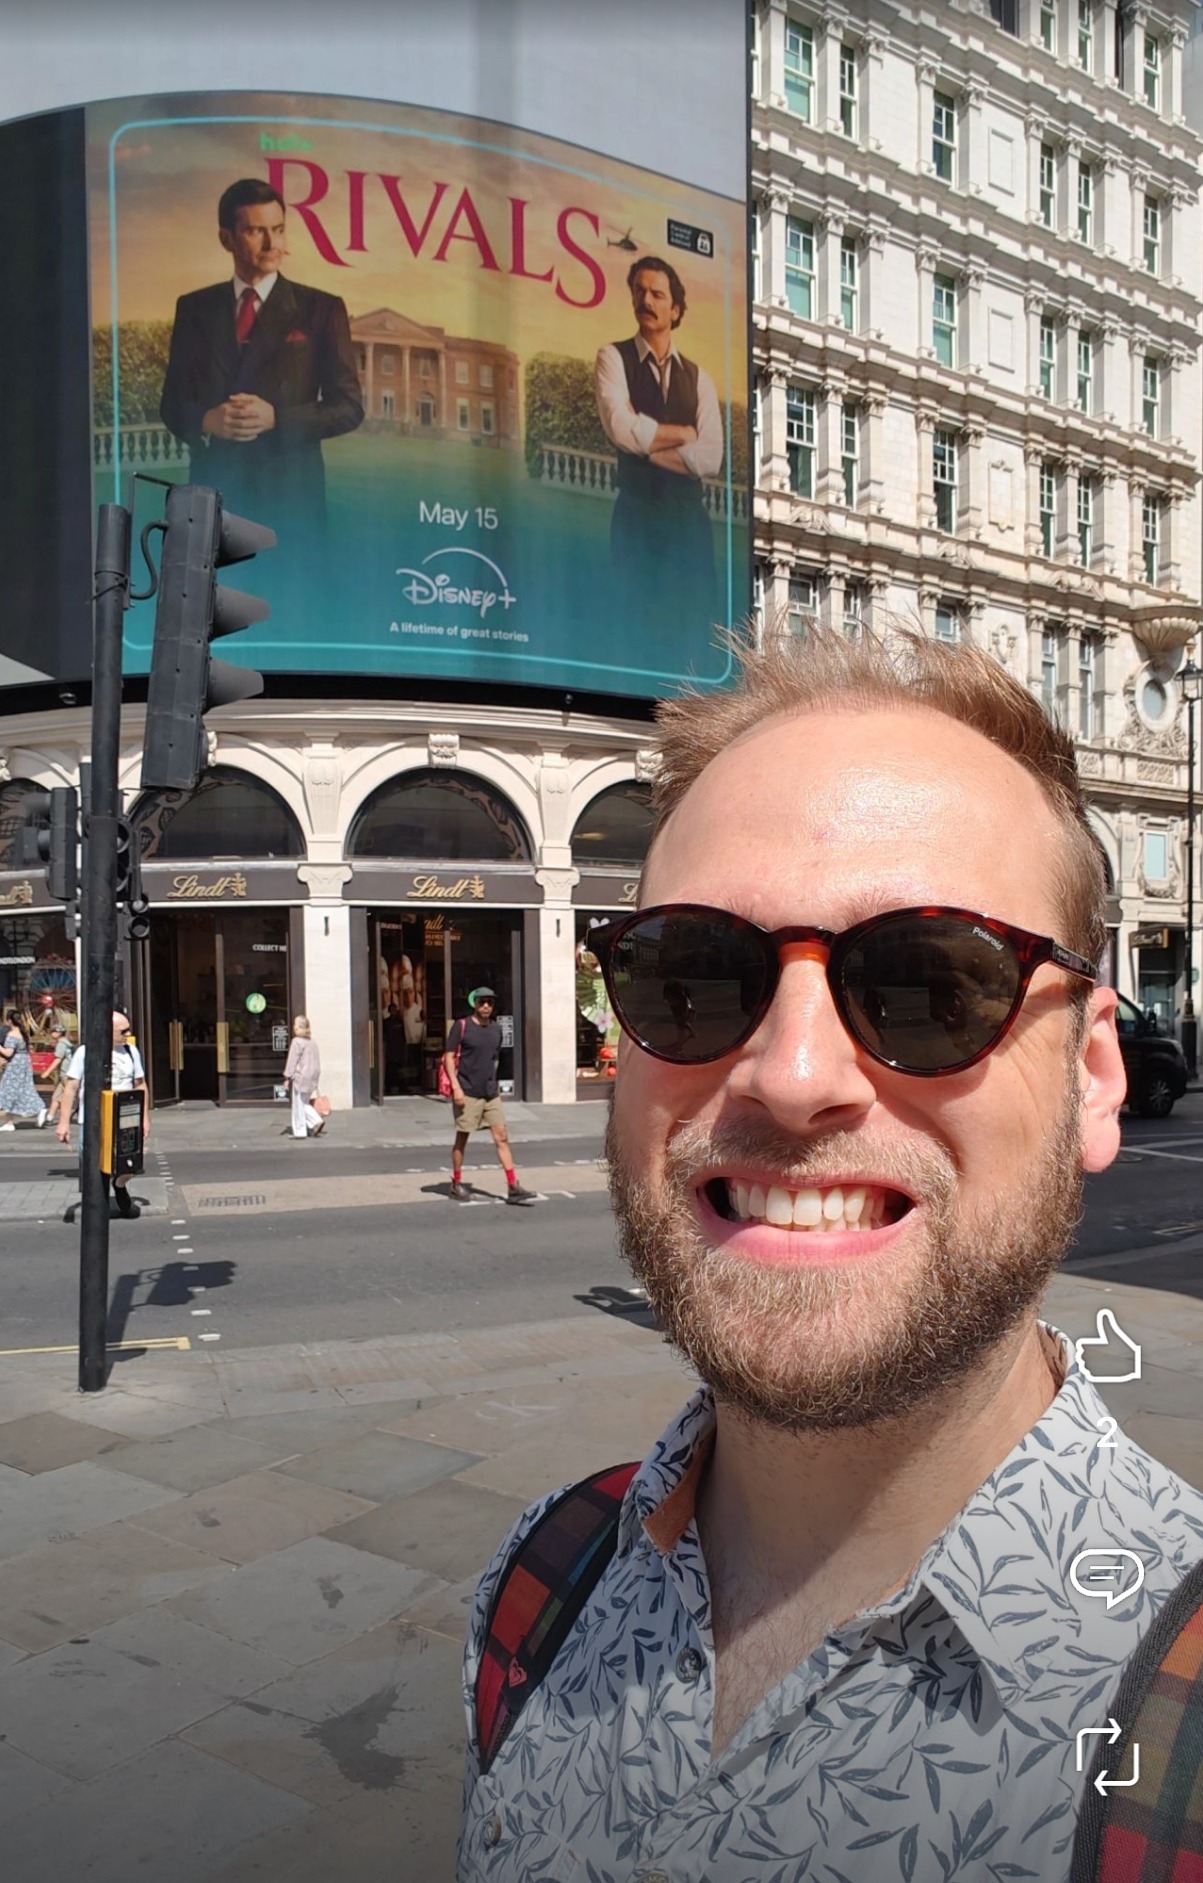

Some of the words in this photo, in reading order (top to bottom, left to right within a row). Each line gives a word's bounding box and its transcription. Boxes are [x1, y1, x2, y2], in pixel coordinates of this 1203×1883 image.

[264, 157, 607, 309] RIVALS
[419, 500, 469, 531] May
[475, 507, 499, 530] 15
[389, 621, 400, 633] A
[401, 622, 444, 635] lifetime
[446, 625, 459, 636] of
[460, 627, 491, 639] great
[492, 630, 530, 643] stories
[166, 874, 232, 898] Lindt
[406, 874, 470, 898] Lindt
[972, 926, 1005, 951] Polaroid
